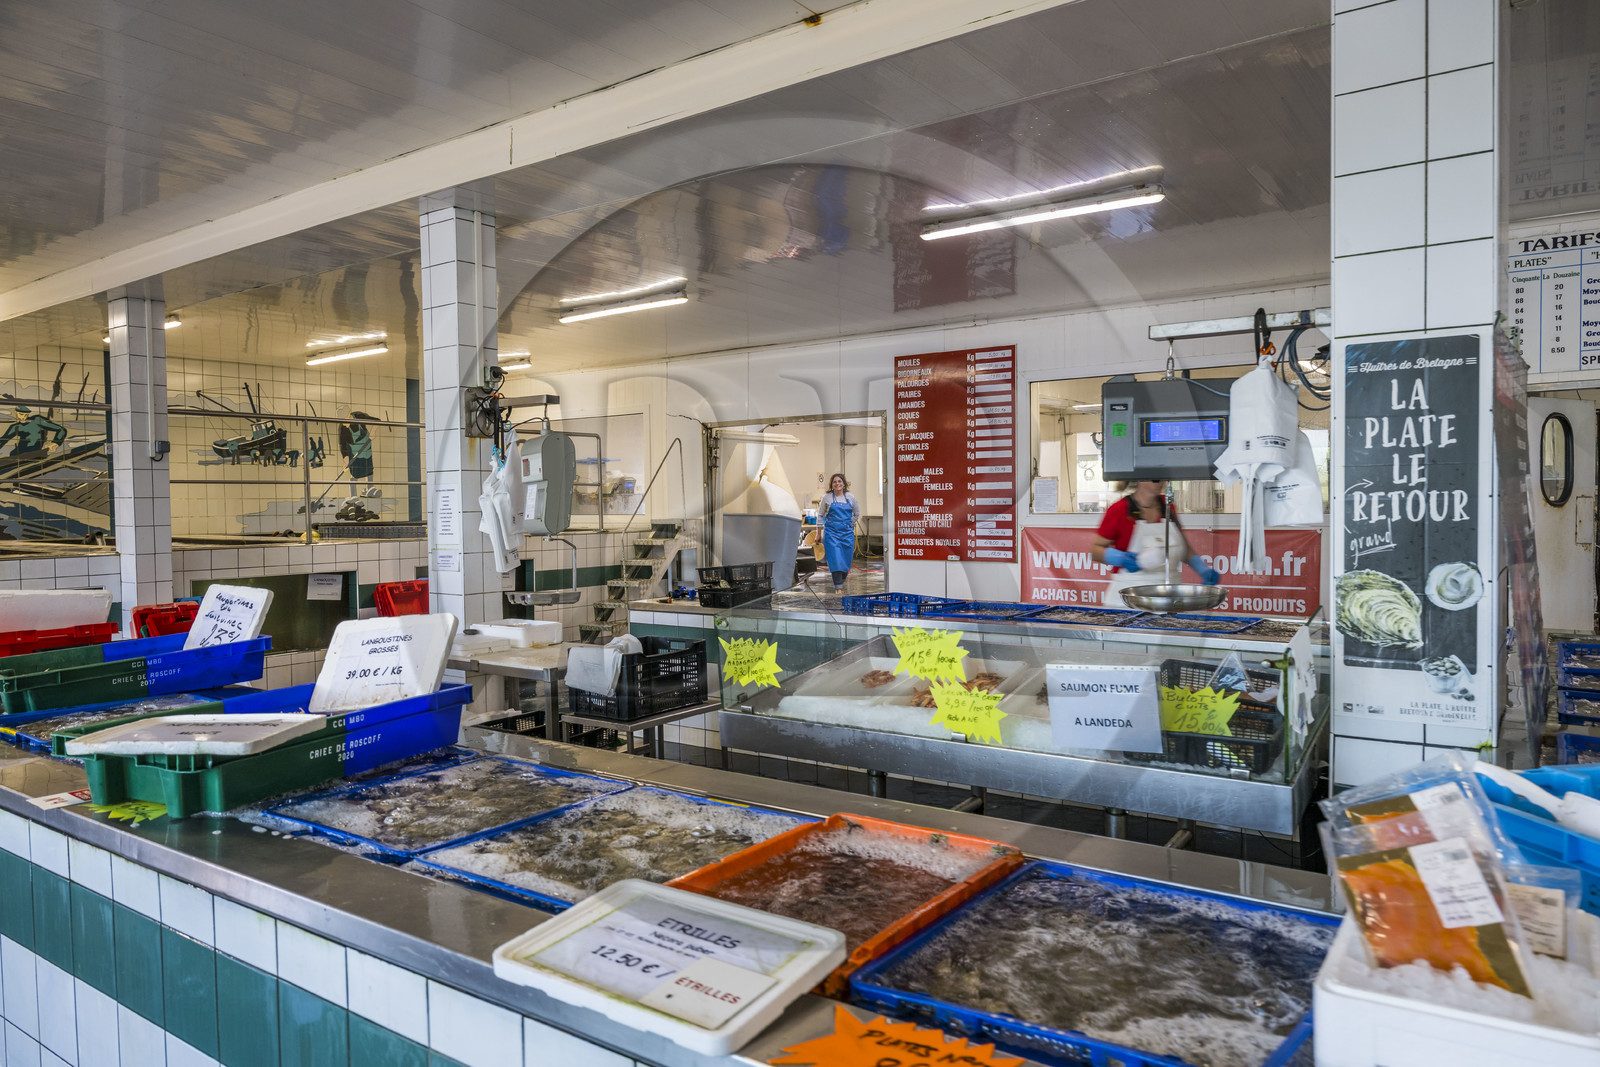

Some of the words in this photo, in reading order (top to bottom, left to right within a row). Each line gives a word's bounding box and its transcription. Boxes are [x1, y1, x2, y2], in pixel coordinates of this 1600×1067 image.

[1512, 275, 1540, 283] Cinquante
[1553, 271, 1580, 279] Douzaine
[898, 359, 920, 367] MOULES
[1399, 360, 1412, 370] de
[1413, 357, 1464, 369] Bretagne
[898, 368, 932, 378] BIGORNEAUX
[898, 379, 930, 388] PALOURDES
[898, 390, 921, 399] PRAIRES
[1391, 378, 1429, 410] LA
[898, 401, 925, 409] AMANDES
[898, 412, 920, 420] COQUES
[1364, 414, 1457, 448] PLATE
[898, 443, 929, 451] PETONCLES
[923, 467, 944, 475] MALES
[1392, 453, 1427, 486] LE
[1352, 489, 1470, 523] RETOUR
[923, 513, 953, 521] FEMELLES
[898, 520, 928, 528] LANGOUSTE
[898, 538, 934, 546] LANGOUSTES
[1350, 517, 1394, 569] grand
[898, 548, 924, 556] ETRILLES
[1032, 587, 1078, 602] ACHATS
[1081, 590, 1097, 603] EN
[1233, 597, 1306, 613] PRODUITS
[361, 635, 413, 646] LANGOUSTINES
[368, 645, 399, 654] GROSSES
[112, 675, 134, 685] CRIEE
[137, 673, 146, 681] DE
[150, 668, 182, 678] ROSCOFF
[346, 668, 370, 680] 39.00
[373, 667, 380, 676] €
[390, 666, 403, 675] KG
[140, 678, 156, 687] 2017
[1061, 683, 1106, 693] SAUMON
[1110, 684, 1140, 693] FUME
[332, 718, 346, 728] CCI
[349, 714, 365, 724] MBO
[1075, 717, 1082, 726] A
[1084, 717, 1133, 728] LANDEDA
[309, 746, 332, 759] CRIEE
[336, 743, 346, 753] DE
[349, 733, 381, 749] ROSCOFF
[338, 750, 354, 762] 2020
[657, 917, 742, 950] ETRILLES
[591, 945, 642, 968] 12.50
[642, 963, 659, 973] €
[674, 976, 742, 1005] ÉTRILLES
[859, 1028, 939, 1058] PLATES
